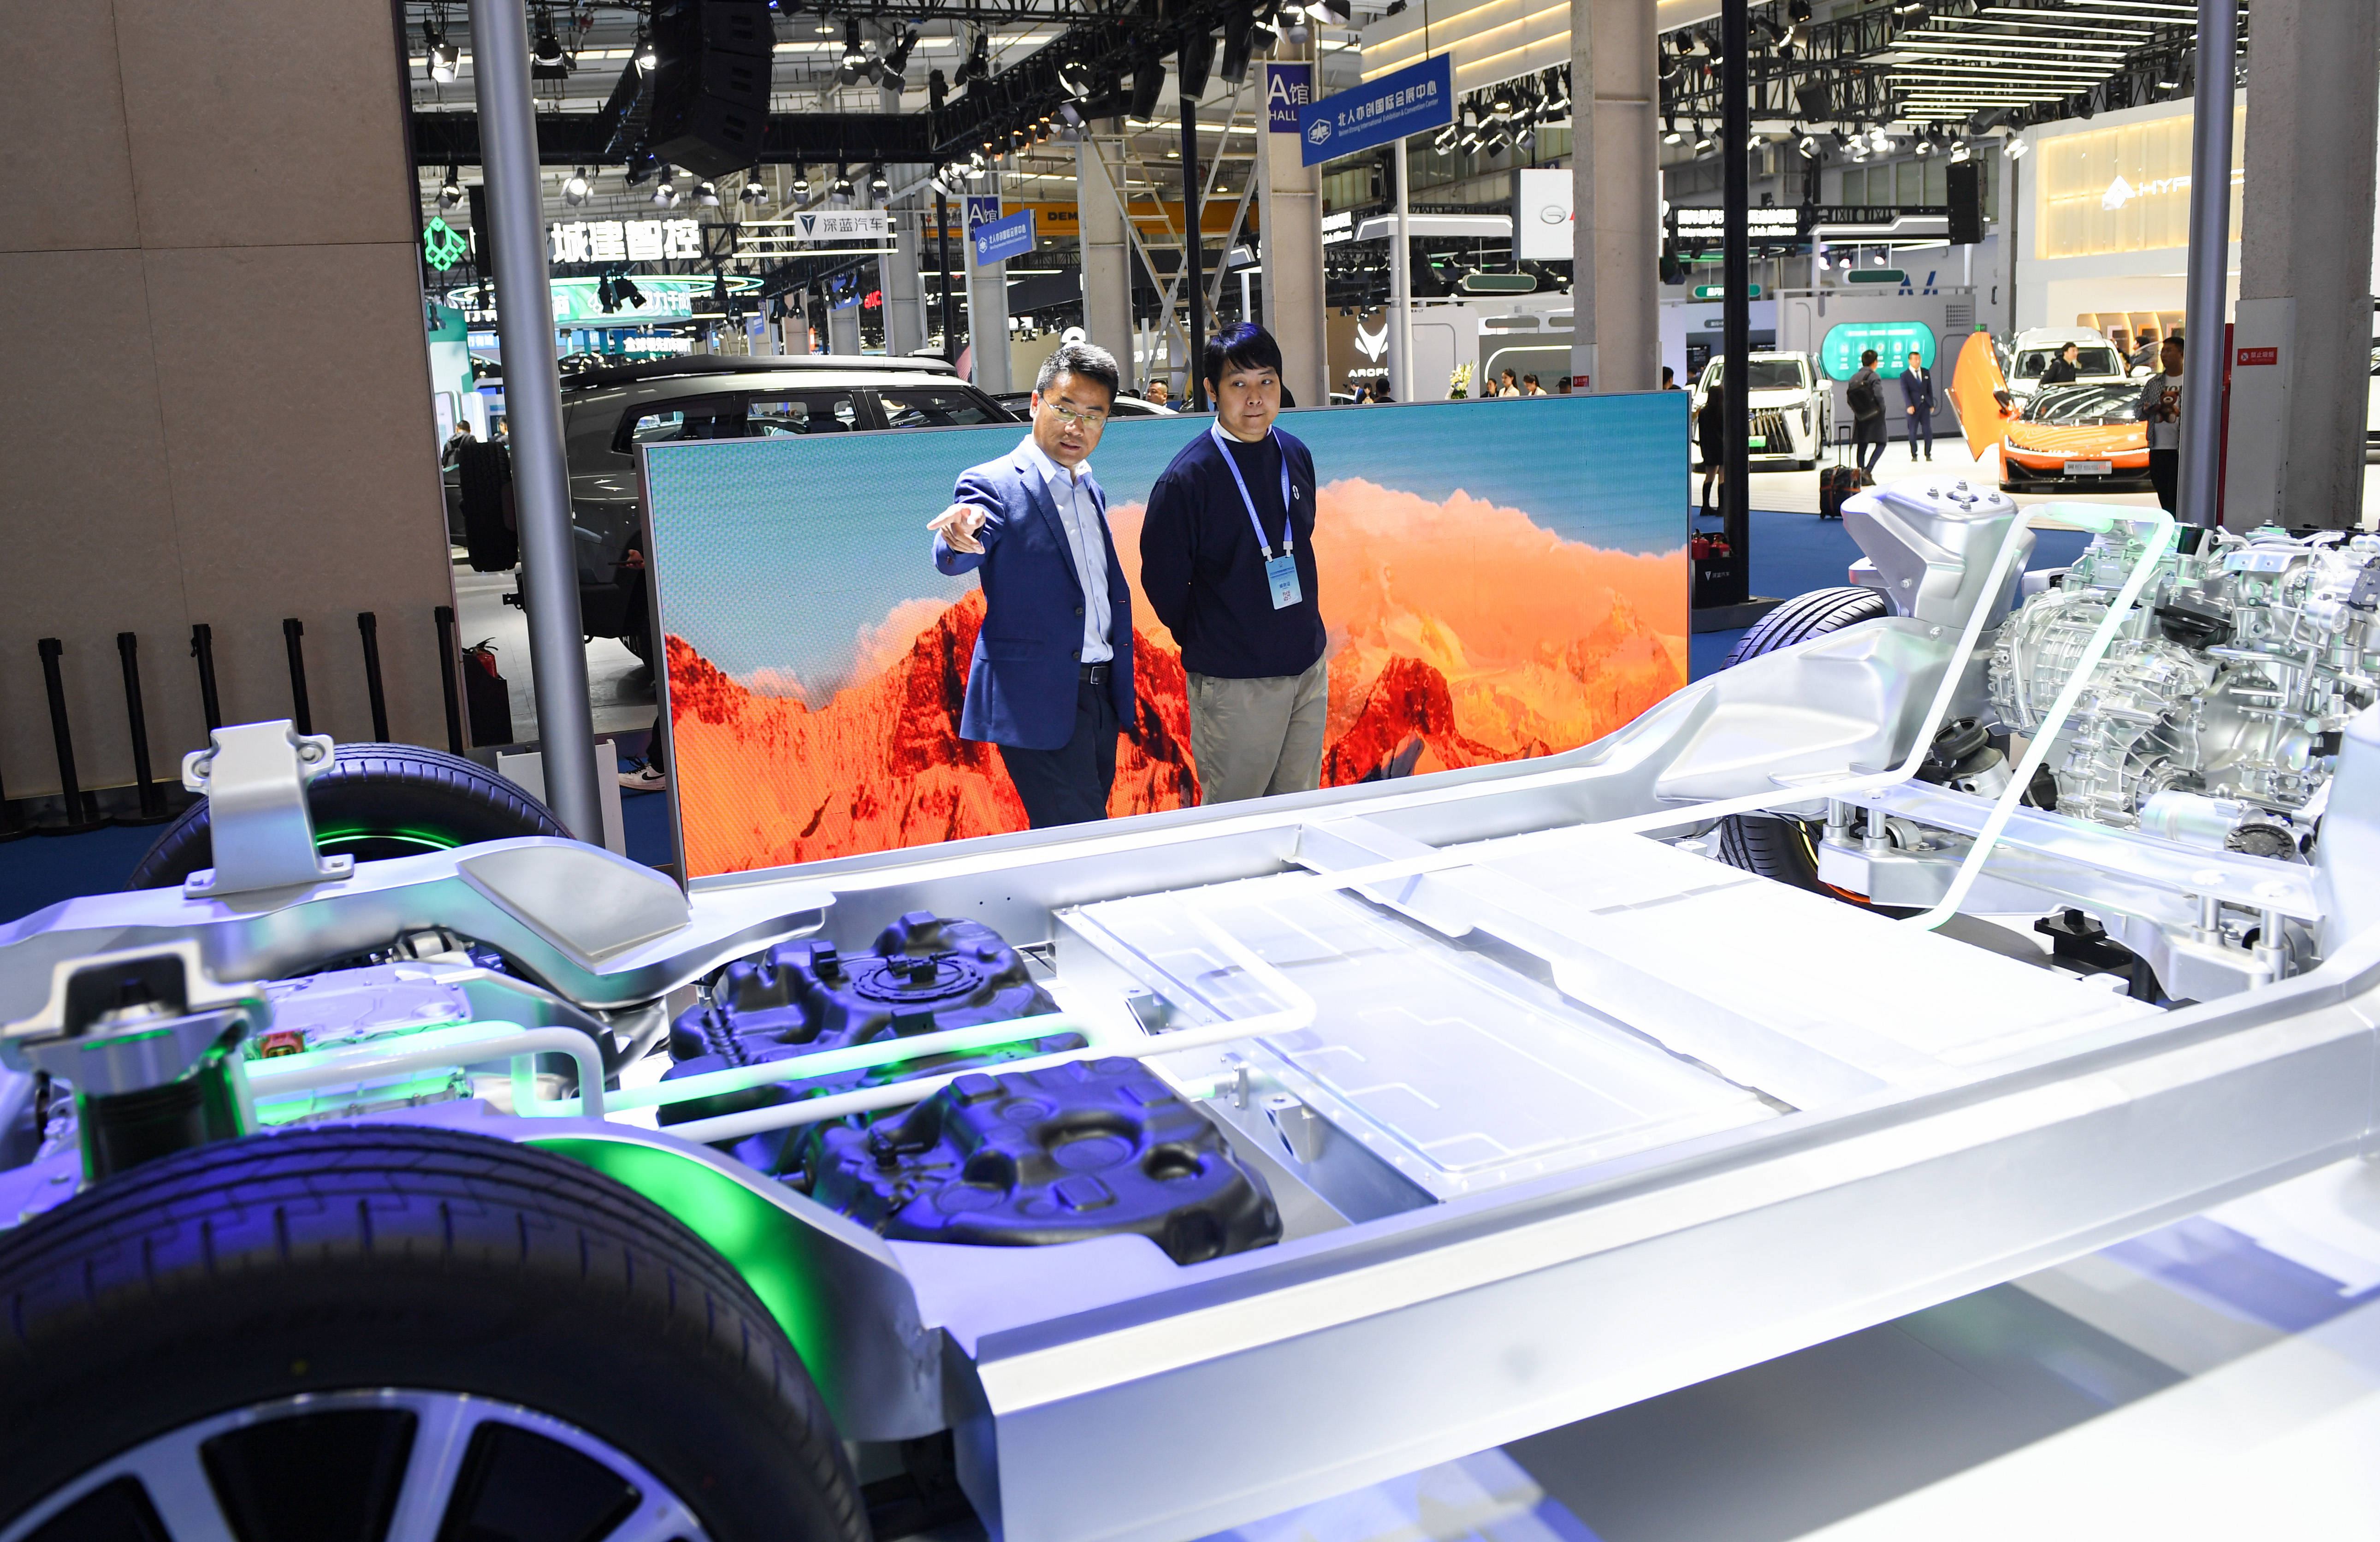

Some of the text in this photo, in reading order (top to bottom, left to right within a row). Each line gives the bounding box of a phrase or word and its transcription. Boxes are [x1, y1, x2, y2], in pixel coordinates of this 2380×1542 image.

[1268, 74, 1309, 105] A馆
[1338, 80, 1437, 127] 北人亦创国际会展中心
[1269, 110, 1297, 121] HALL
[823, 217, 883, 232] 深蓝汽车
[551, 218, 702, 263] 城建智控
